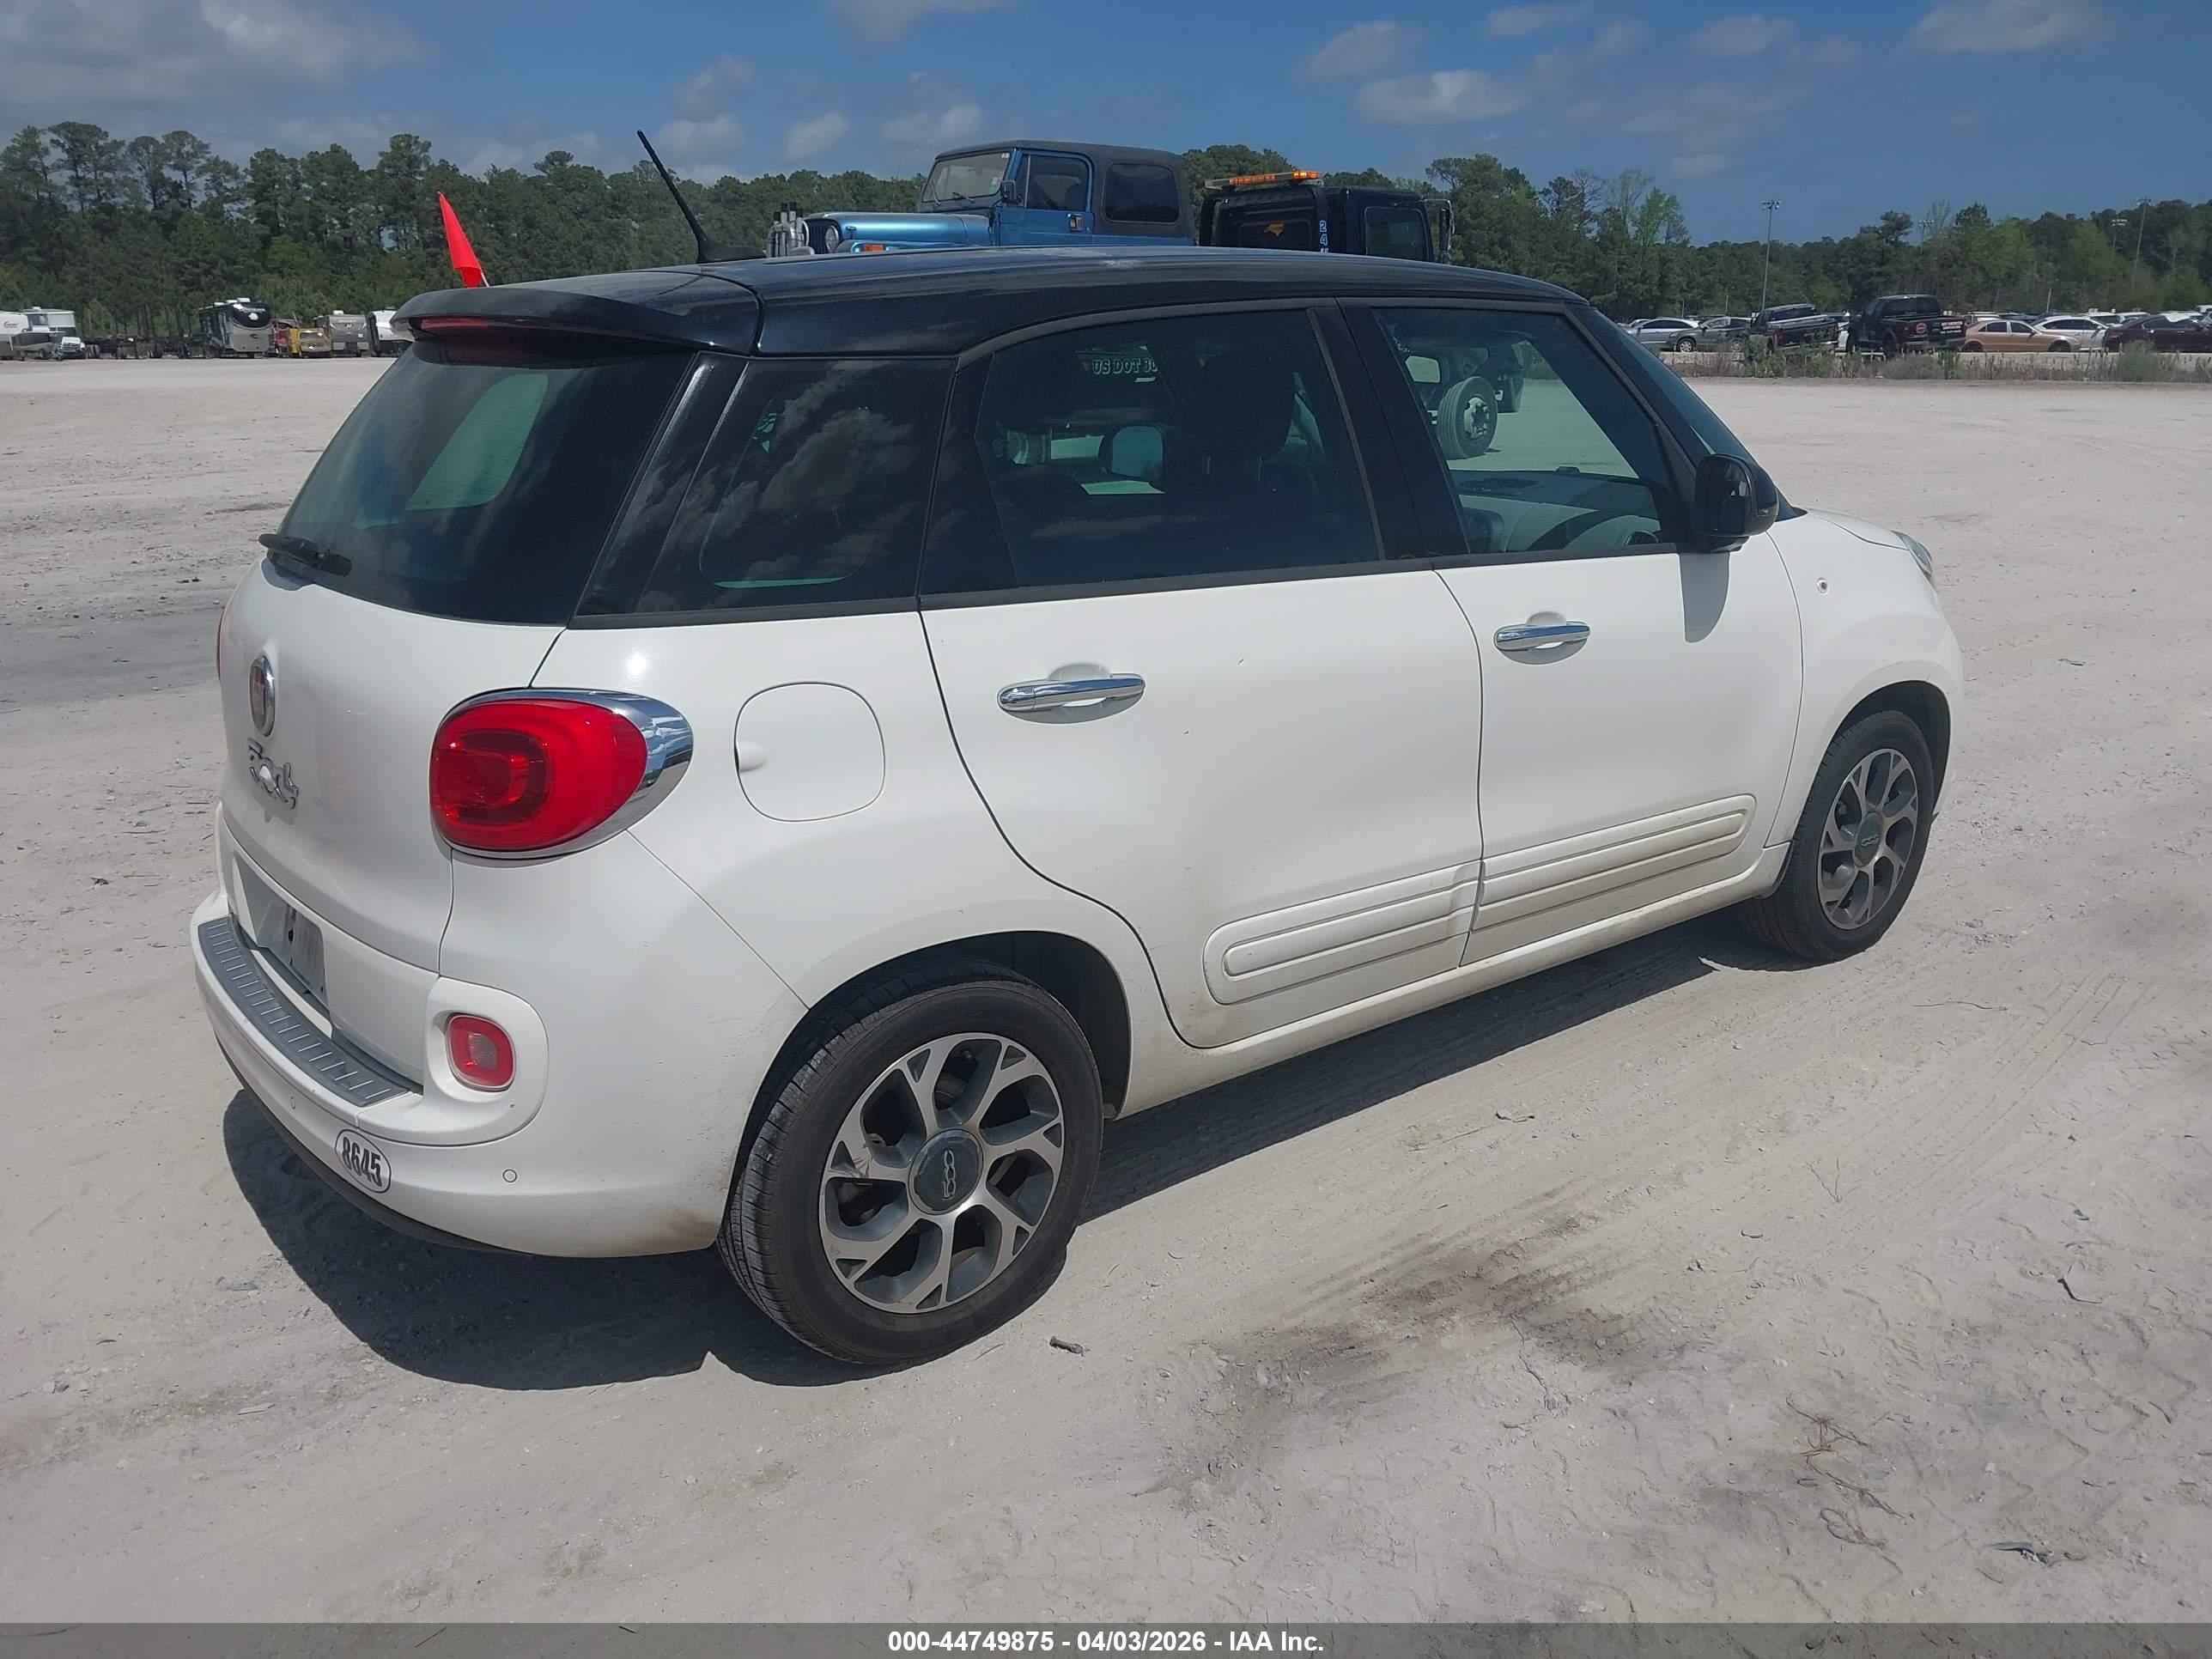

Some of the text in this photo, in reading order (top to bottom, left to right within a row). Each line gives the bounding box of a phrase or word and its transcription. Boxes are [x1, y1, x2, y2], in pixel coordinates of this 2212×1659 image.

[1092, 359, 1112, 374] US
[1113, 358, 1141, 374] DOT
[343, 1136, 382, 1187] 8645
